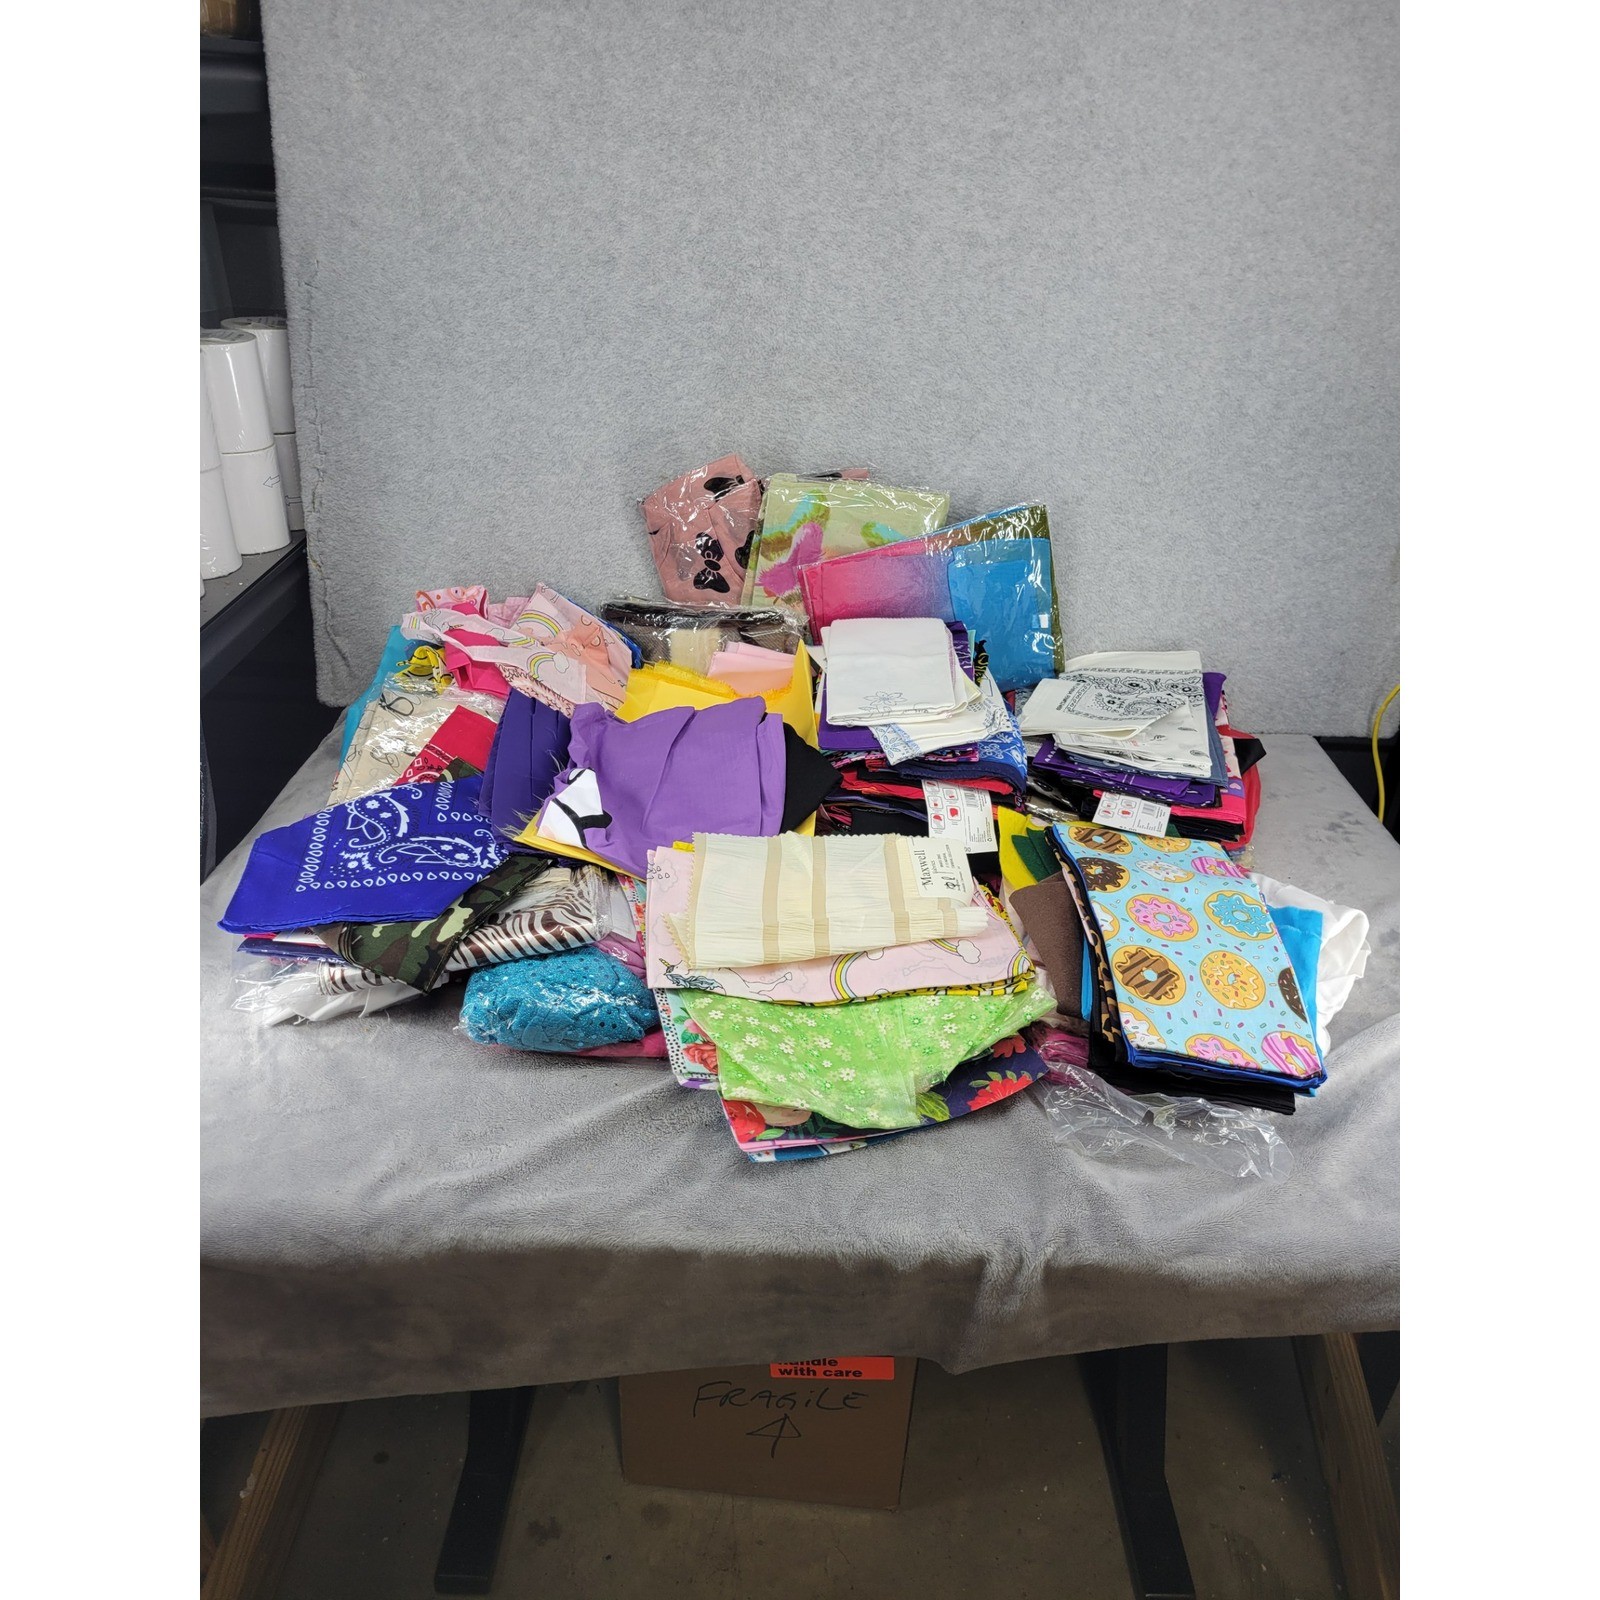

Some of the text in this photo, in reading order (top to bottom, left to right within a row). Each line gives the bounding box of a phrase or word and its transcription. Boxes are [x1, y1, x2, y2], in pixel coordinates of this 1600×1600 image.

[913, 849, 933, 886] Maxwell
[778, 1367, 863, 1378] with care
